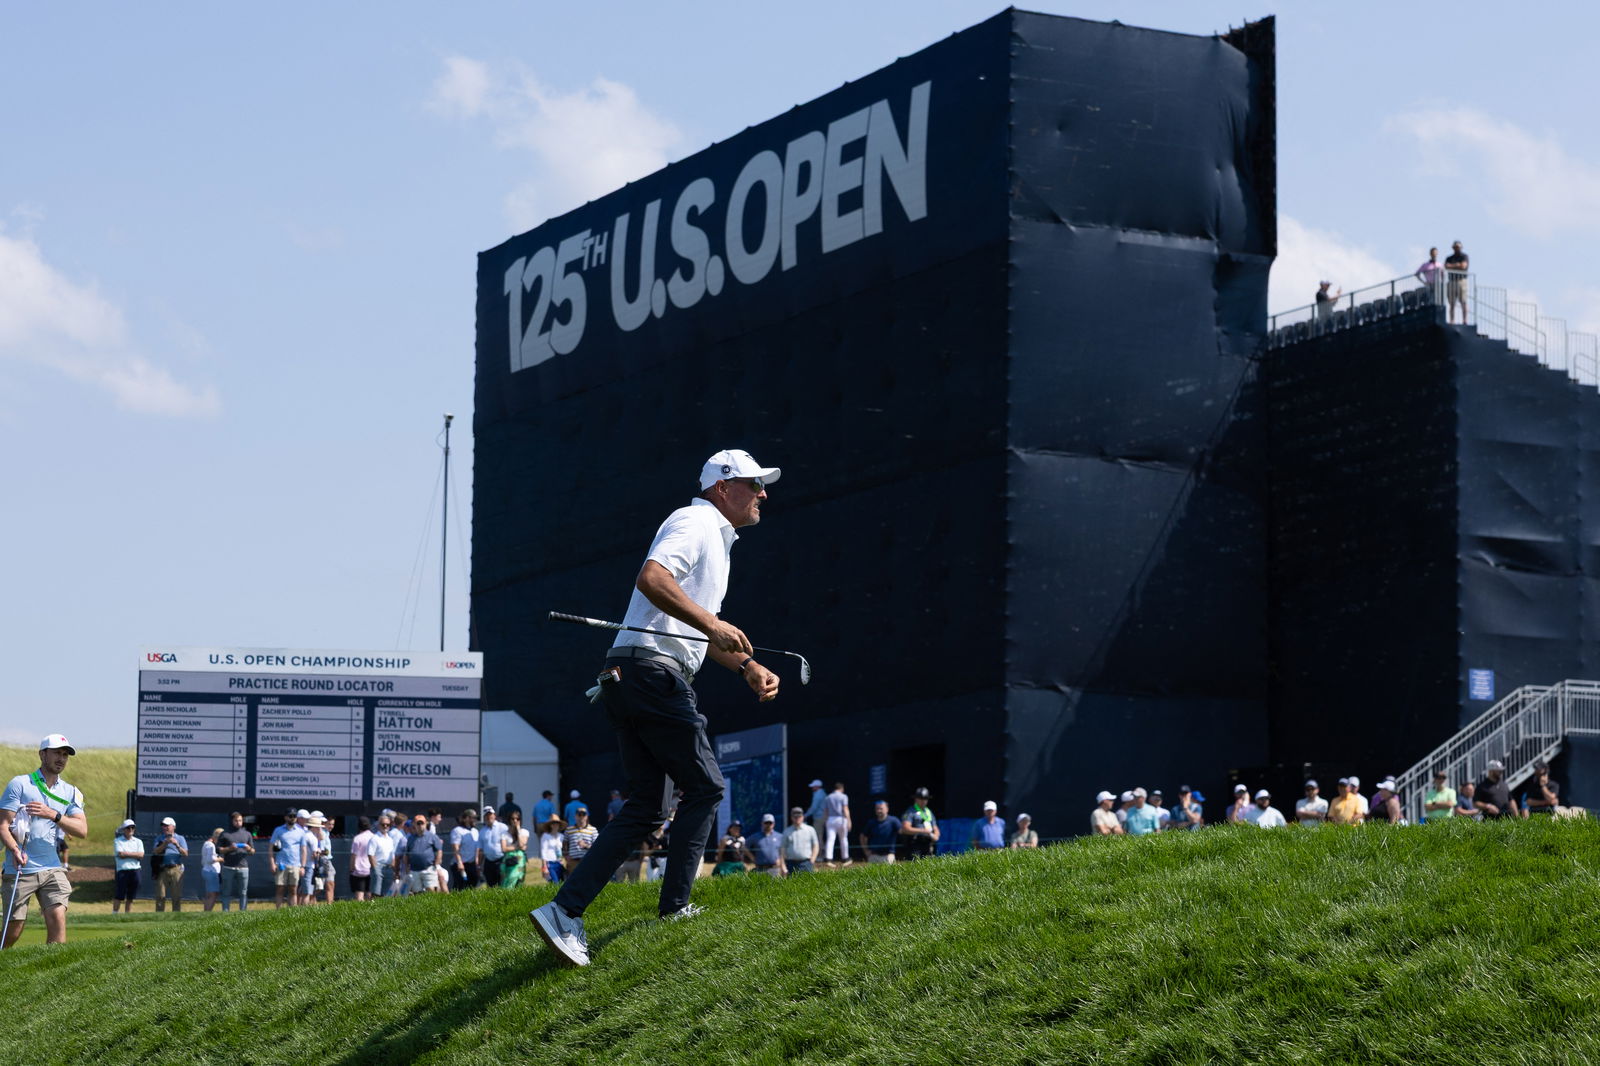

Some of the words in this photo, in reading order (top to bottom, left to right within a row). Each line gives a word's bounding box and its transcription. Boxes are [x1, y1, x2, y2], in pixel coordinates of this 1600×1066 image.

[147, 653, 177, 662] USGA
[210, 654, 238, 664] U.S.
[245, 655, 285, 666] OPEN
[291, 656, 410, 668] CHAMPIONSHIP
[229, 678, 288, 689] PRACTICE
[291, 679, 334, 690] ROUND
[338, 680, 394, 692] LOCATOR
[378, 717, 432, 729] HATTON
[378, 740, 440, 752] JOHNSON
[377, 764, 451, 776] MICKELSON
[377, 787, 415, 798] RAHM
